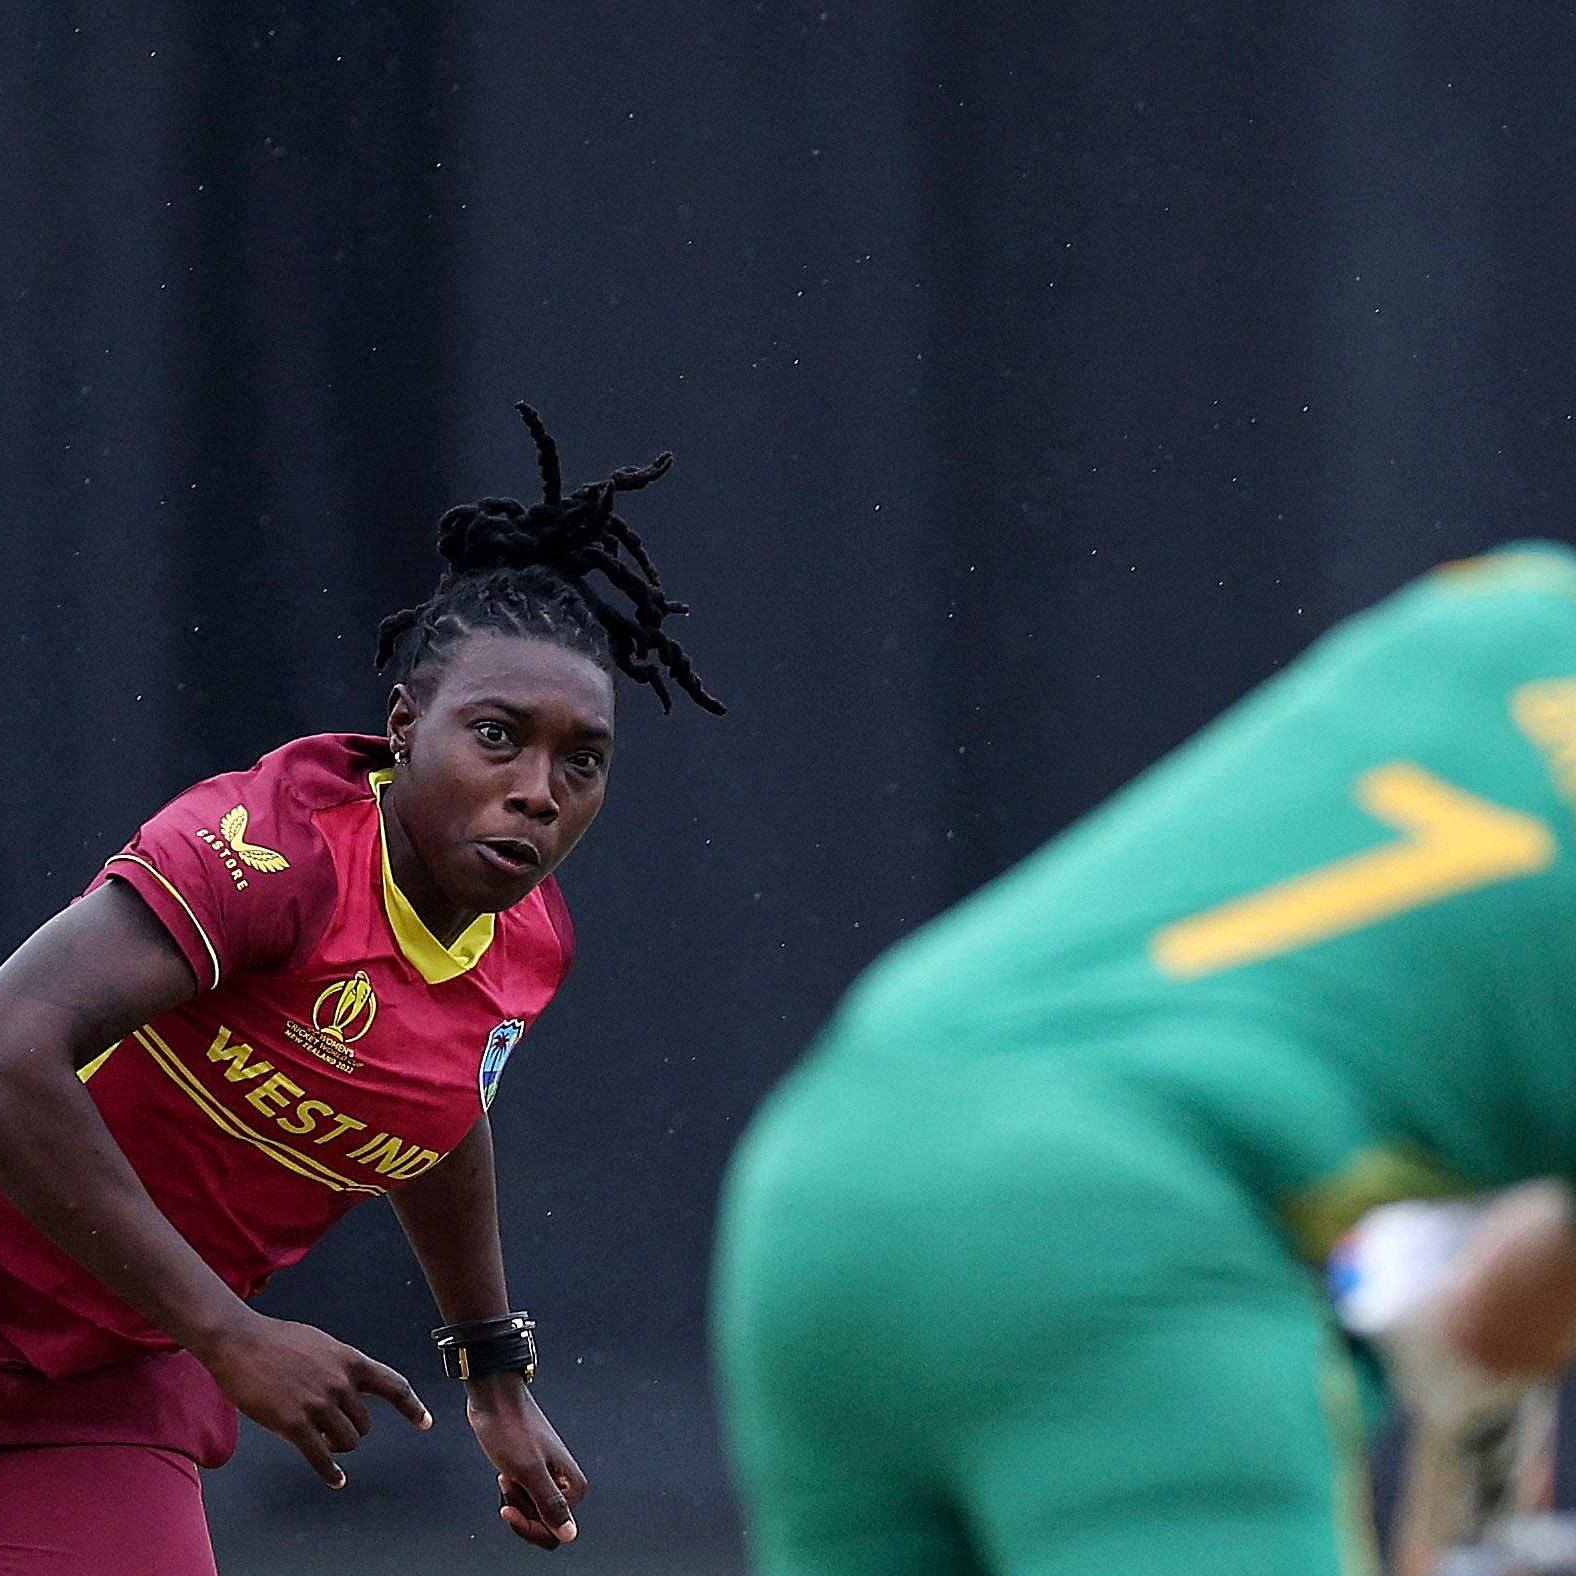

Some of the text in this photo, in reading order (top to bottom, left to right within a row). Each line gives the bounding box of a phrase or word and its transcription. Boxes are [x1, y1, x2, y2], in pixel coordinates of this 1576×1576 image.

[196, 829, 249, 891] CASTORE
[284, 1029, 304, 1044] NEW
[301, 1042, 337, 1065] ZEALAND
[286, 1020, 320, 1045] CRICKET
[205, 1025, 450, 1180] WEST IND
